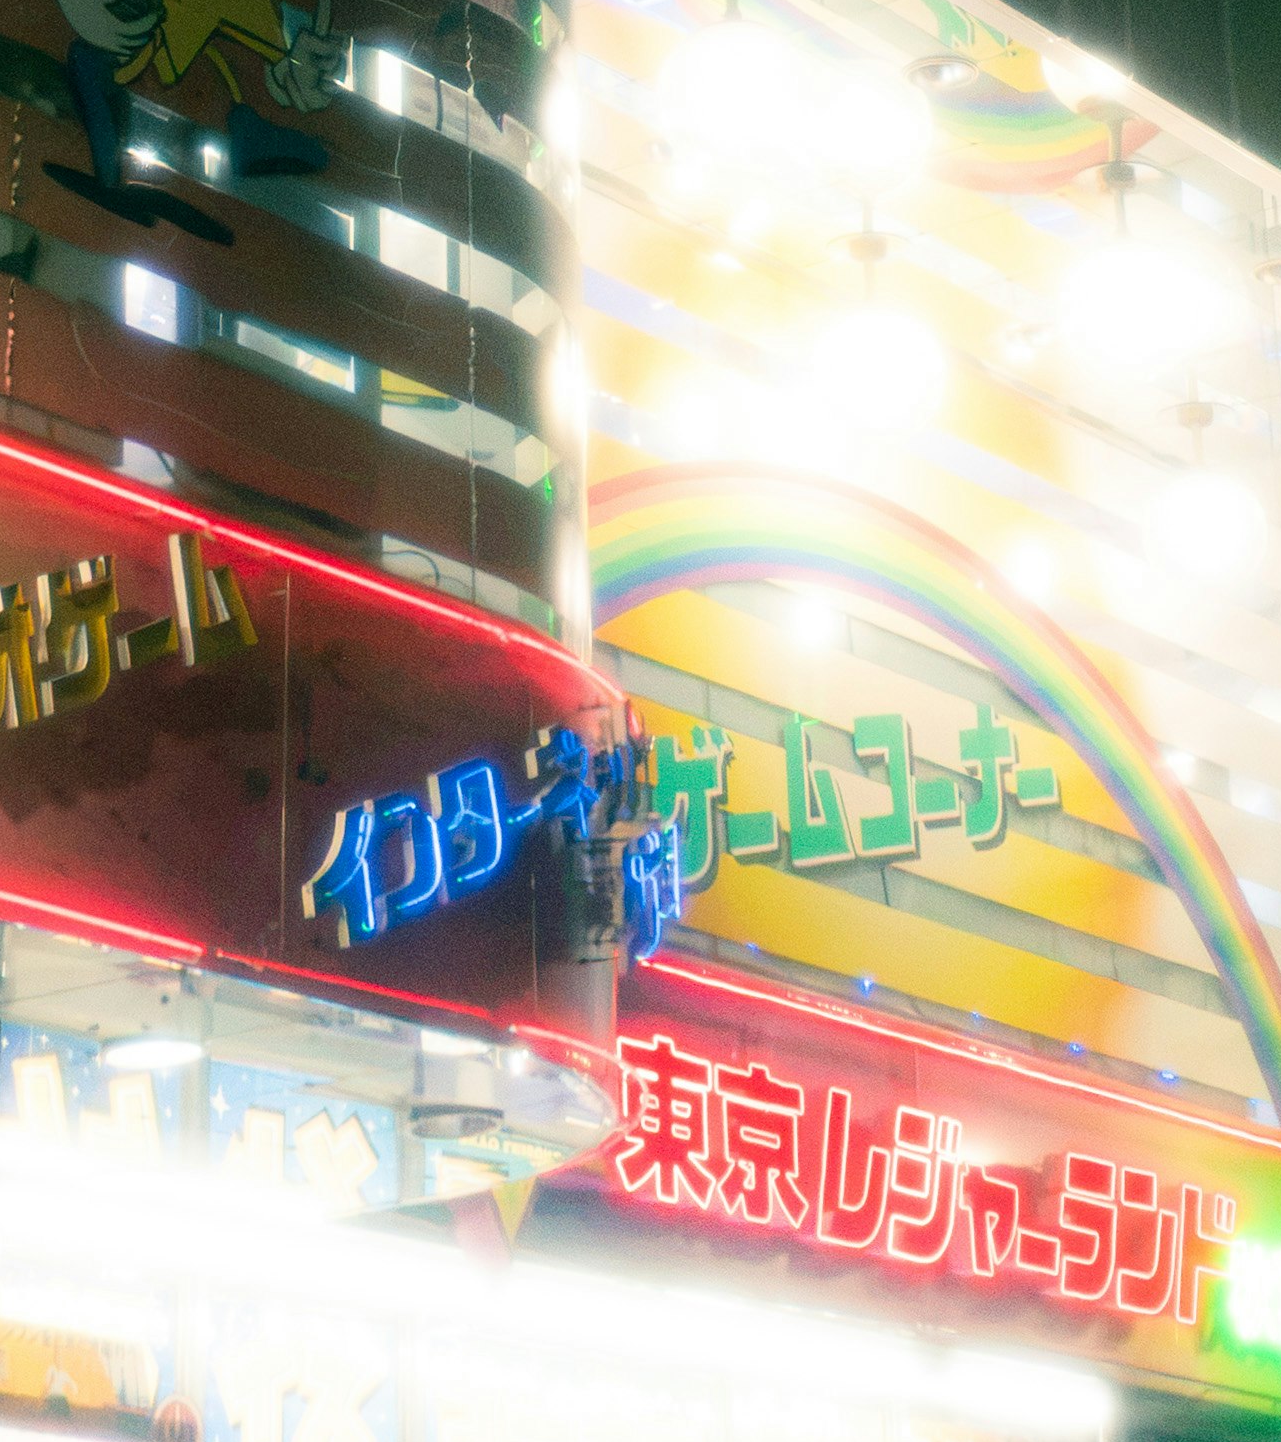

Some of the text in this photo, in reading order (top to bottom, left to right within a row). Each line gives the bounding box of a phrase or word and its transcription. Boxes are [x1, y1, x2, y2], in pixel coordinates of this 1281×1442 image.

[652, 703, 1062, 888] ゲームコーナー
[615, 1034, 1236, 1325] 東京レジャーランド
